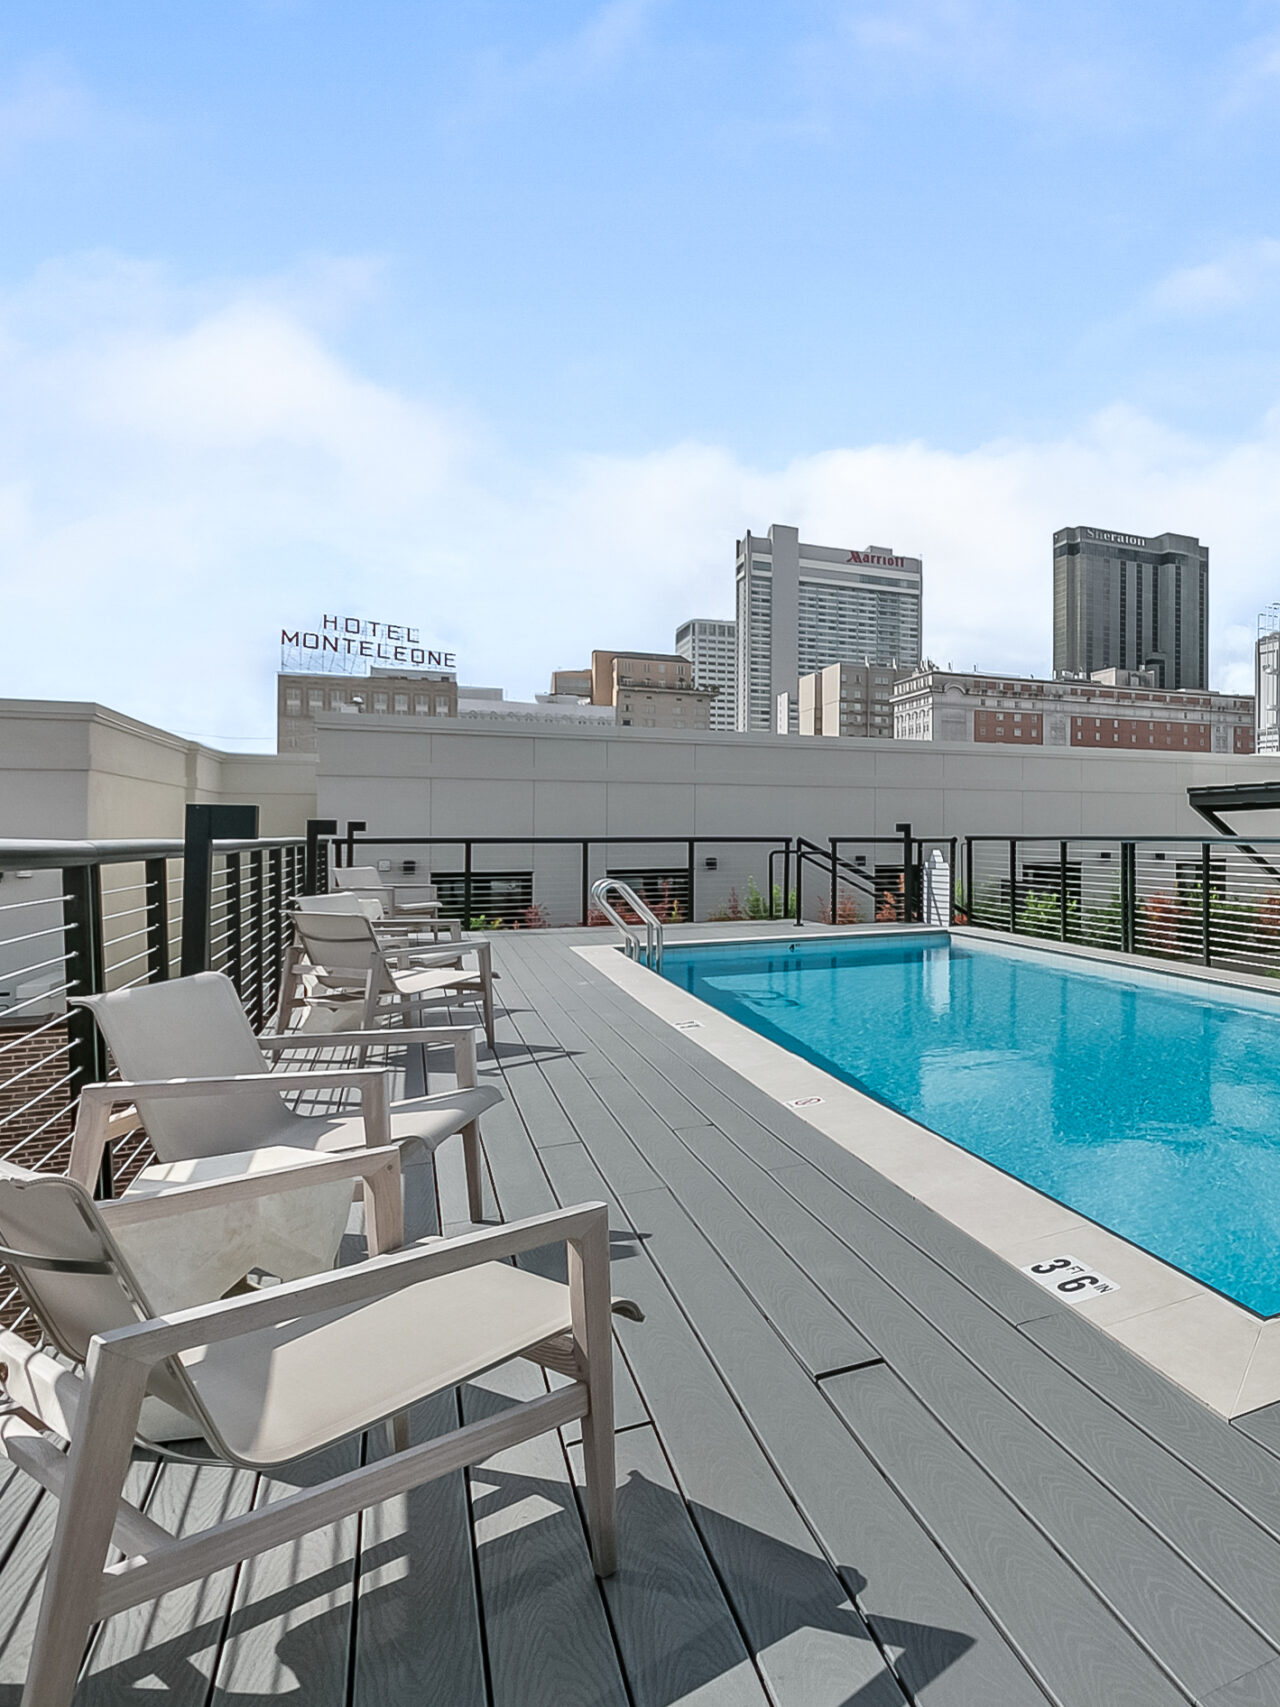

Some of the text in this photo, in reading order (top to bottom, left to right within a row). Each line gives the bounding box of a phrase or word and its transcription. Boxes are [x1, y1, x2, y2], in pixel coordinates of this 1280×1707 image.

[1086, 528, 1146, 546] Sheraton
[846, 551, 905, 568] Marriott
[323, 614, 420, 643] HOTEL
[281, 629, 457, 668] MONTELEONE
